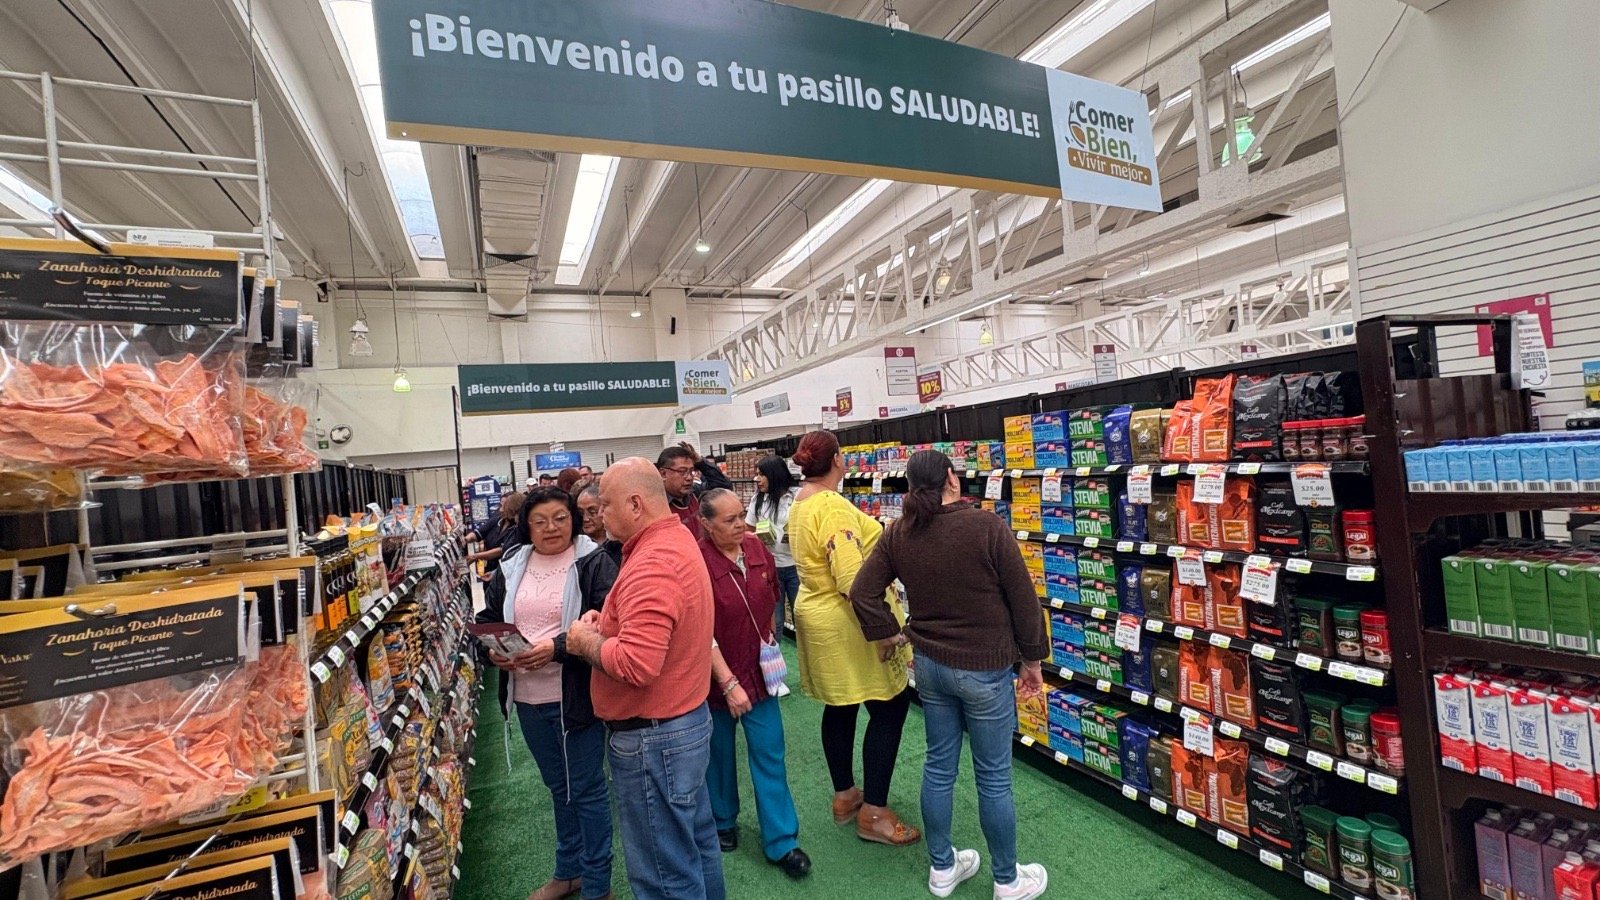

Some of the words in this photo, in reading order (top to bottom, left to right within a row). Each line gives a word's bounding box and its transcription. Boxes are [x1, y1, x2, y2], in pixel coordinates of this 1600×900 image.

[409, 13, 684, 83] ¡Bienvenido
[697, 60, 717, 87] a
[727, 60, 768, 94] tu
[778, 72, 883, 111] pasillo
[890, 86, 1041, 139] SALUDABLE!
[1075, 100, 1134, 134] Comer
[1086, 128, 1138, 162] Bien,
[1077, 150, 1106, 173] Vivir
[1110, 160, 1144, 181] mejor
[38, 260, 121, 274] Zanahoria
[123, 264, 222, 278] Deshidratada
[85, 277, 124, 288] Toque
[125, 279, 172, 288] Picante
[688, 370, 719, 378] Comer
[467, 382, 540, 396] ¡Bienvenido
[543, 384, 550, 392] a
[553, 382, 566, 392] tu
[569, 381, 605, 394] pasillo
[607, 378, 671, 390] SALUDABLE!
[920, 380, 941, 395] 10%
[1069, 421, 1095, 435] STEVIA
[1071, 451, 1098, 464] STEVIA
[1074, 491, 1099, 504] STEVIA
[1075, 520, 1102, 534] STEVIA
[1077, 560, 1105, 576] STEVIA
[1080, 589, 1108, 607] STEVIA
[46, 625, 127, 647] Zanahoria
[127, 607, 224, 632] Deshidratada
[92, 637, 129, 652] Toque
[130, 630, 175, 645] Picante
[1084, 630, 1112, 649] STEVIA
[1085, 660, 1113, 680] STEVIA
[1081, 719, 1108, 741] STEVIA
[1084, 747, 1111, 772] STEVIA
